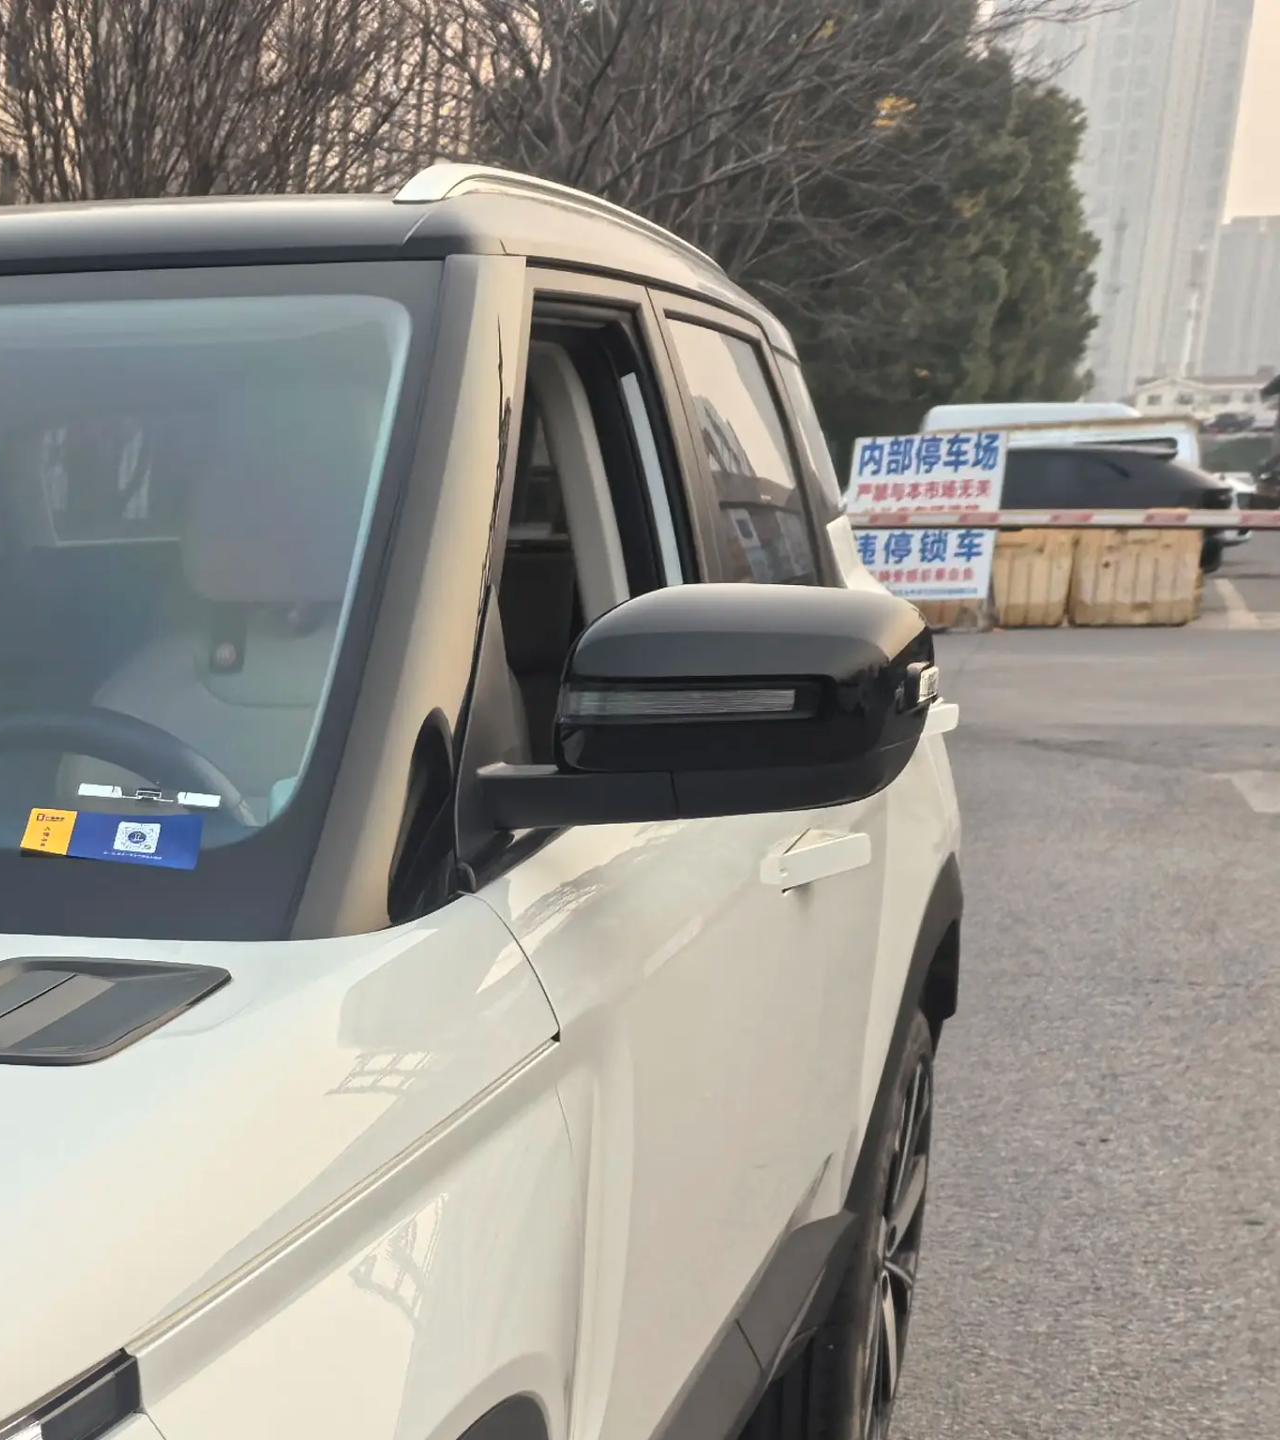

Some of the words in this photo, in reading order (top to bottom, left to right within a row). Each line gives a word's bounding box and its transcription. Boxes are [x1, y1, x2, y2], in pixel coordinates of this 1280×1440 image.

[858, 432, 1000, 477] 内部停车场
